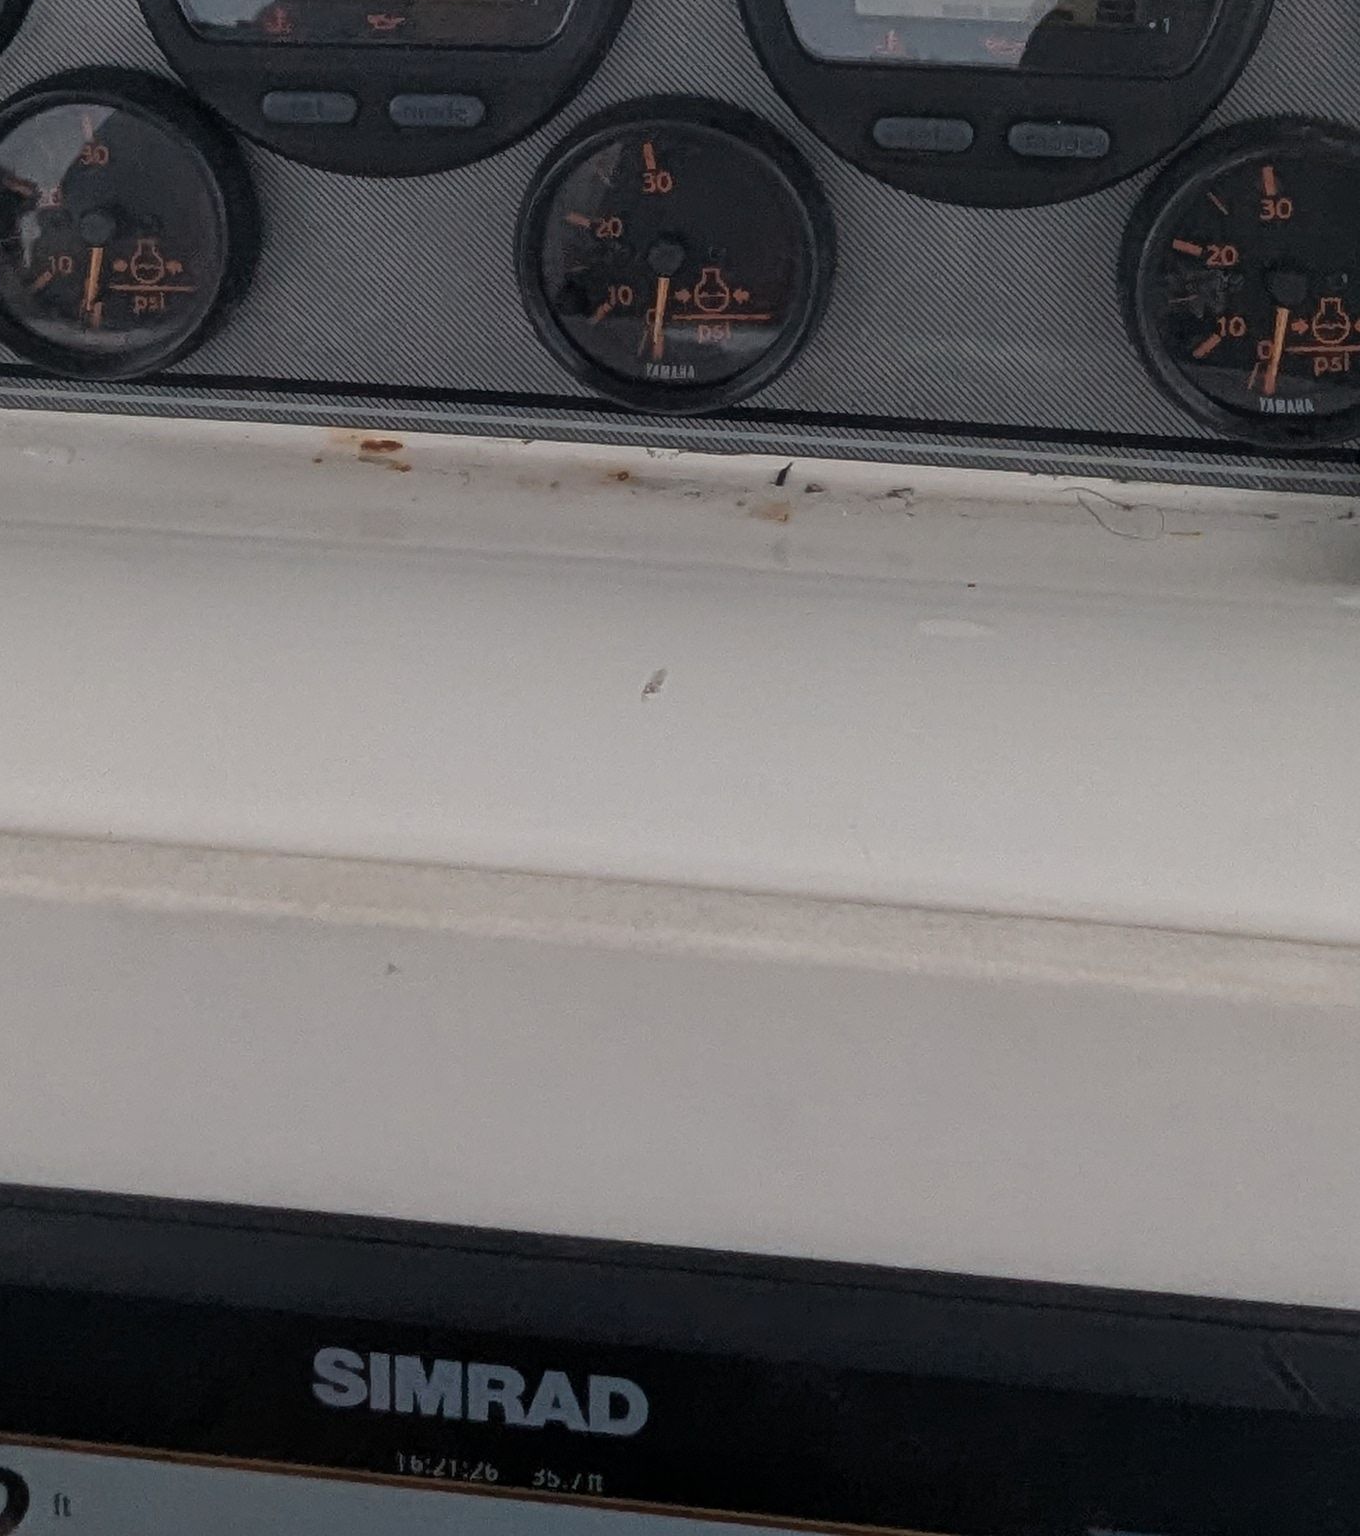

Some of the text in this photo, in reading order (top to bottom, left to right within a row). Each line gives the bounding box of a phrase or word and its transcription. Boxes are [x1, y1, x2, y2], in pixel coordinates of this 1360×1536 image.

[1162, 17, 1171, 34] 1
[641, 170, 675, 193] 30
[1259, 197, 1293, 220] 30
[595, 216, 624, 238] 20
[48, 255, 73, 275] 10
[1206, 244, 1239, 266] 20
[134, 291, 166, 314] psi
[608, 285, 634, 306] 10
[697, 321, 732, 344] psi
[1216, 316, 1247, 337] 10
[646, 363, 697, 380] YAMAHA
[1313, 351, 1350, 377] psi
[1258, 396, 1315, 414] YAMAHA
[311, 1346, 650, 1436] SIMRAD
[53, 1492, 72, 1517] ft
